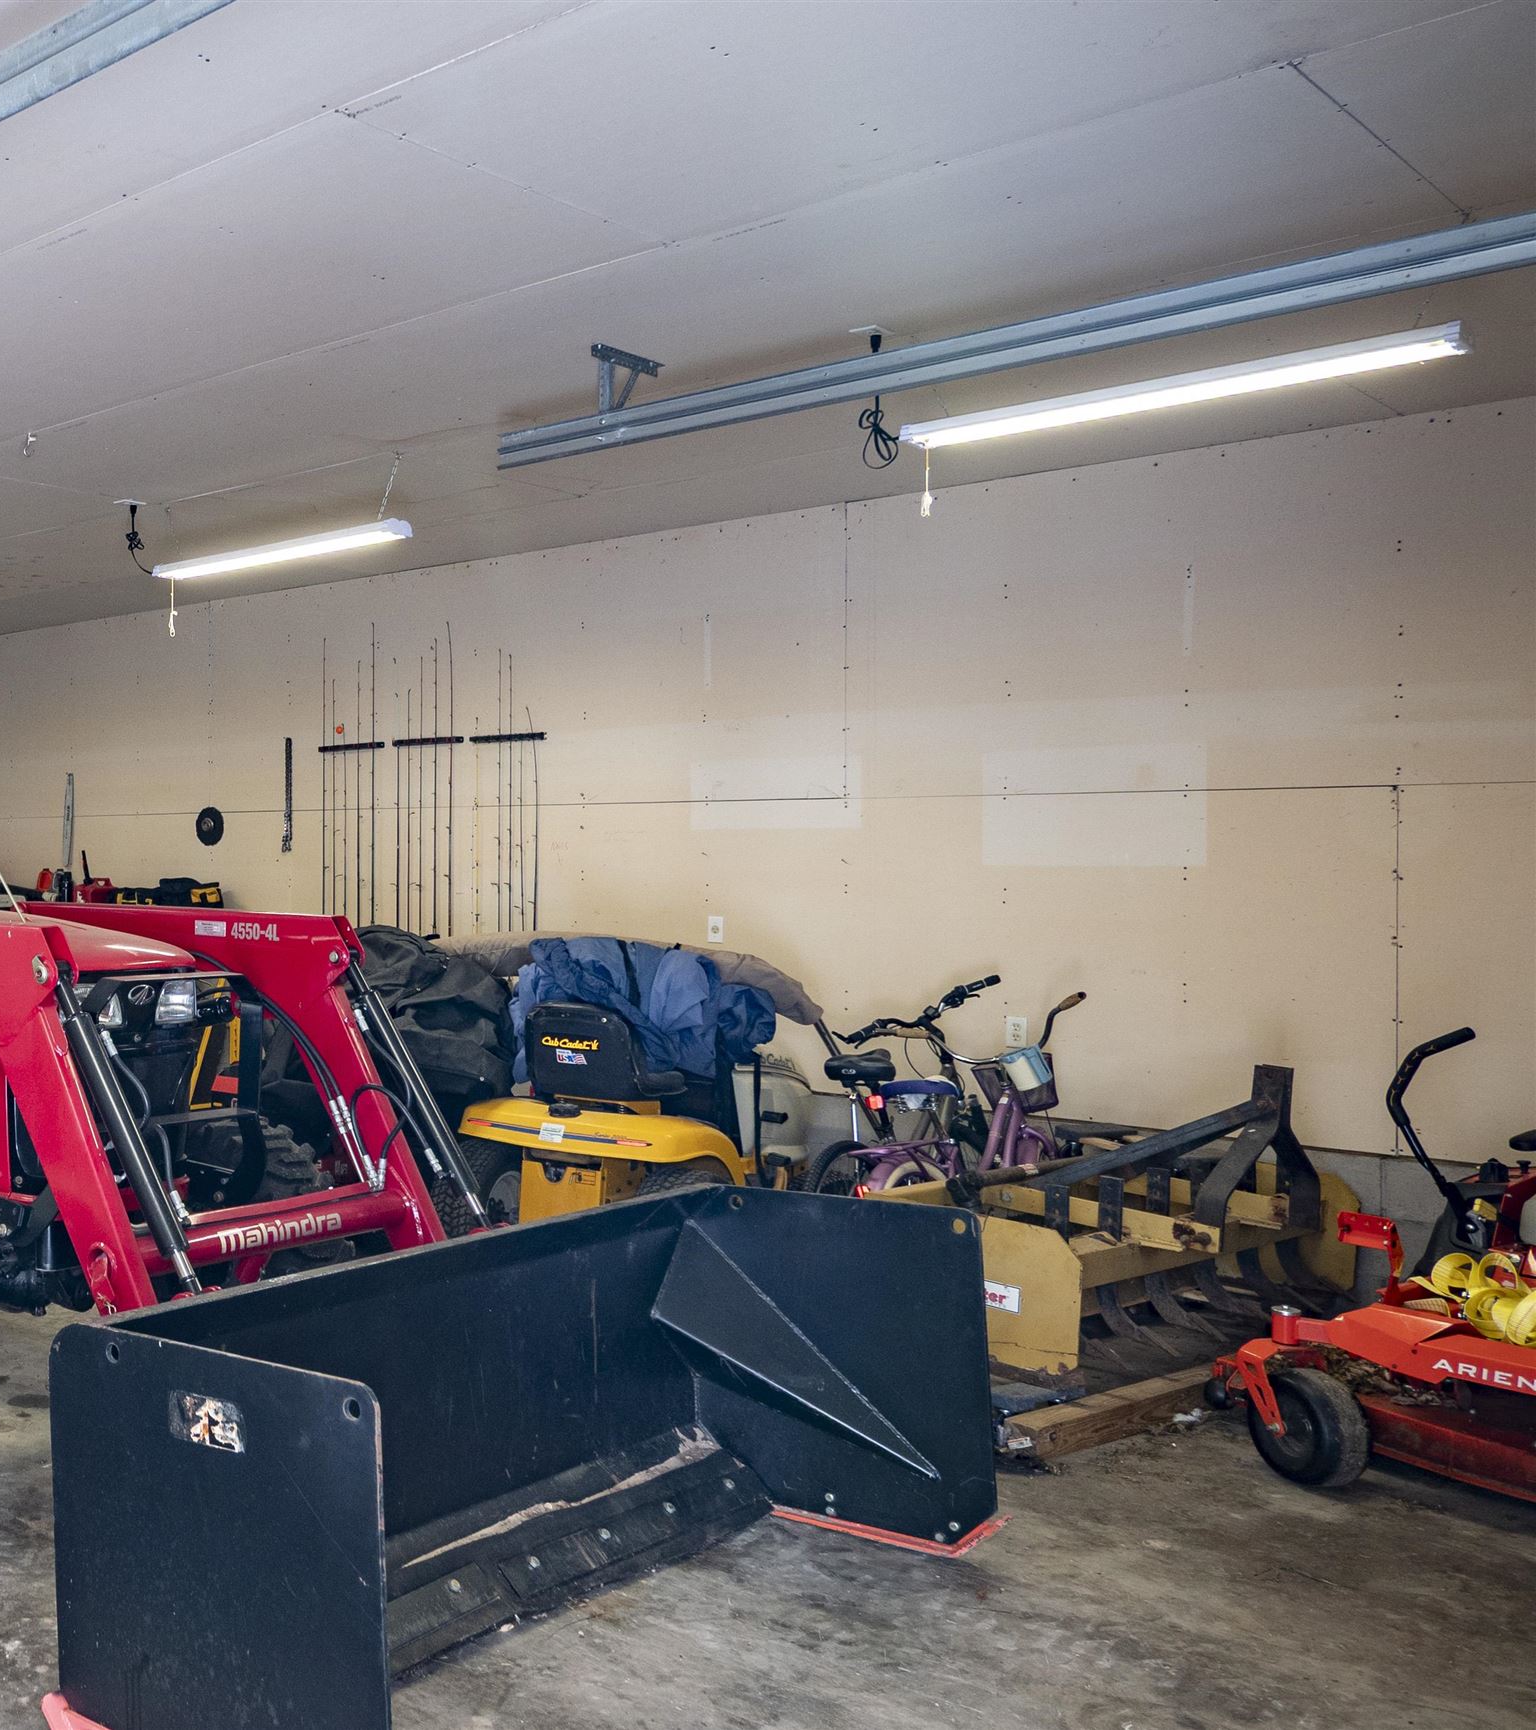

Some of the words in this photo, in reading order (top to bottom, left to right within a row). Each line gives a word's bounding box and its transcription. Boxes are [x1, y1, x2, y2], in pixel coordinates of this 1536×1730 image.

[230, 922, 280, 942] 4550-4L
[541, 1036, 560, 1048] Cub
[560, 1038, 591, 1051] Cadet
[217, 1213, 342, 1254] Mahindra
